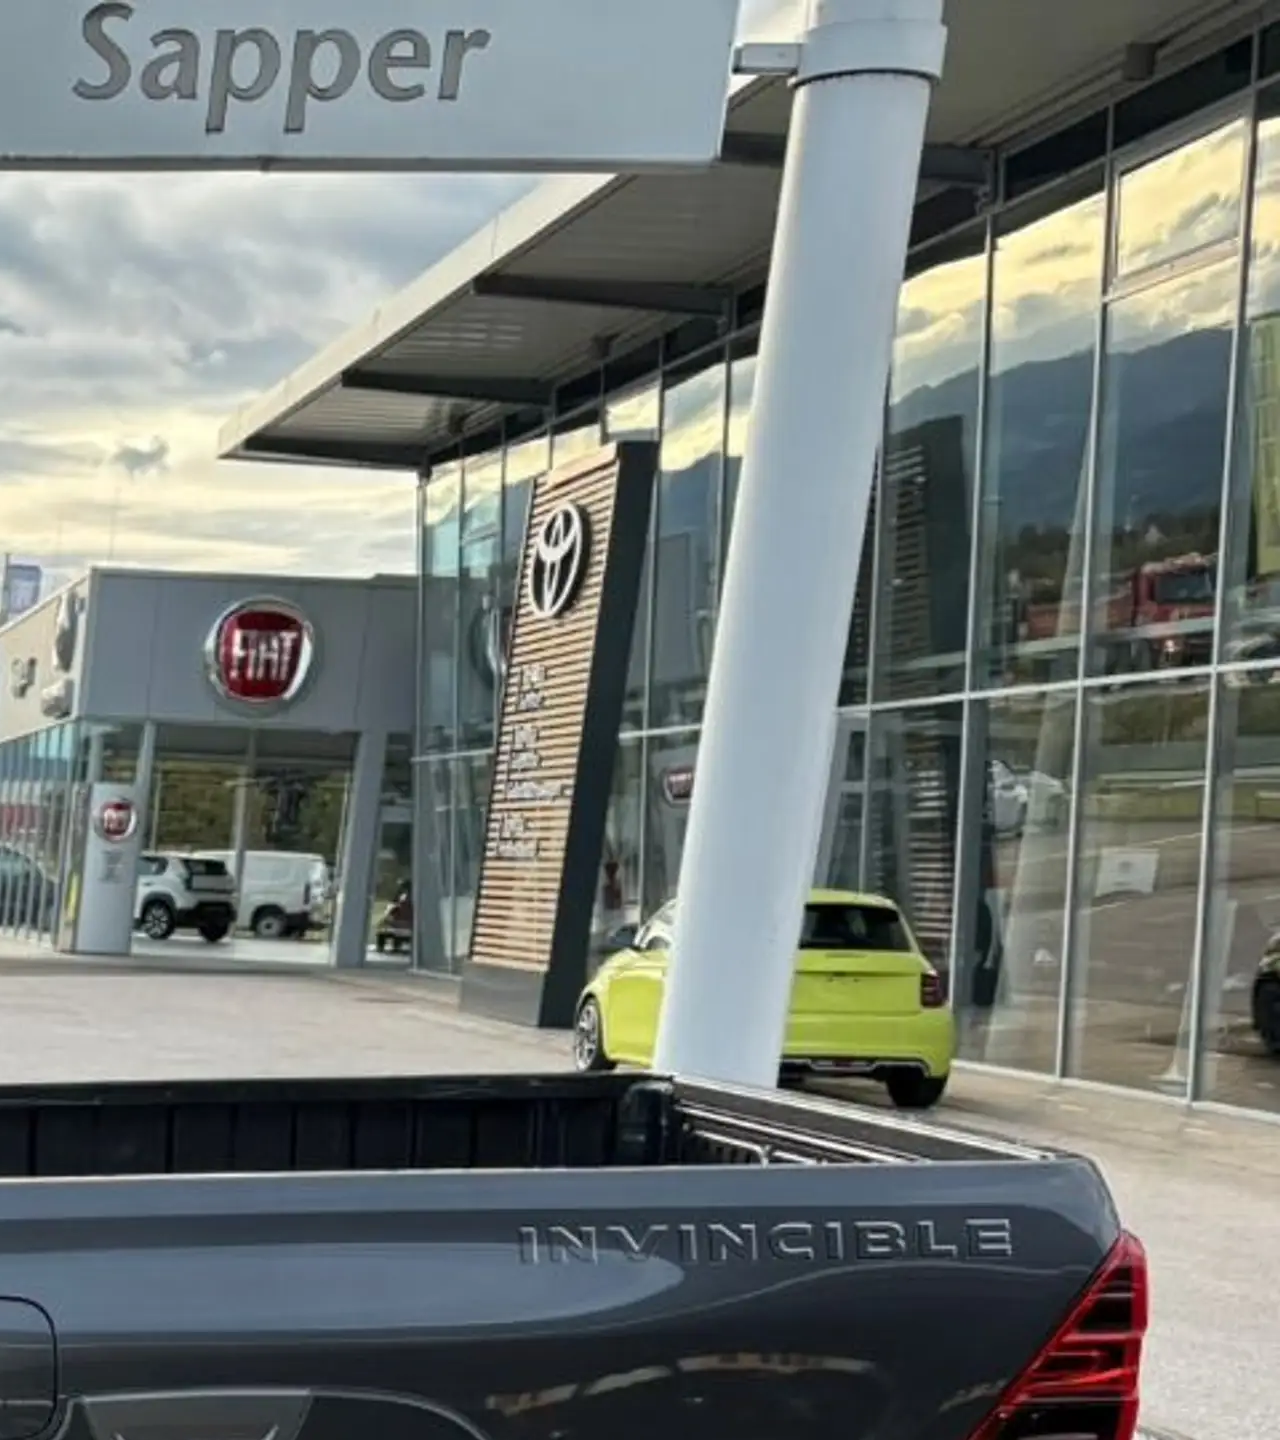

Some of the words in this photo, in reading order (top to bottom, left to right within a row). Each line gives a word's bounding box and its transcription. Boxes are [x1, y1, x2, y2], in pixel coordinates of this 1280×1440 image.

[71, 1, 492, 135] Sapper
[228, 628, 298, 681] FIAT
[518, 1217, 1014, 1265] INVINCIBLE
